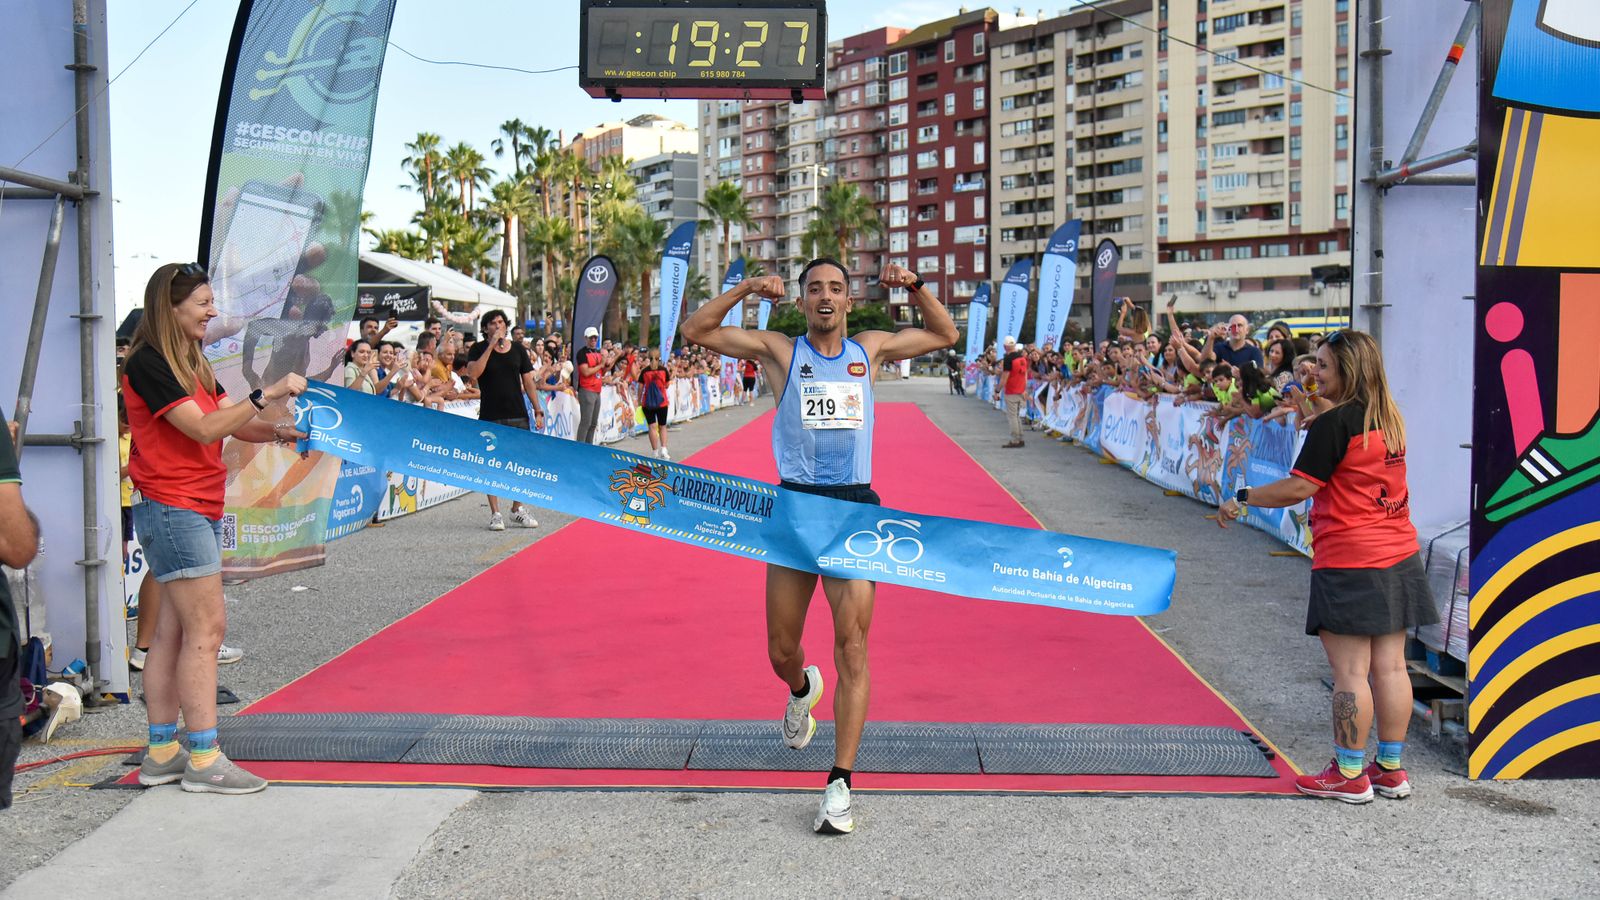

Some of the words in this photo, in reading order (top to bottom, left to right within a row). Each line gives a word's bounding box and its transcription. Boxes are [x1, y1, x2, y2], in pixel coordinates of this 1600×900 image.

[1047, 264, 1062, 332] Sergeyco
[806, 399, 836, 416] 219
[309, 430, 363, 454] BIKES
[411, 438, 450, 457] Puerto
[453, 447, 485, 466] Bahía
[488, 455, 502, 469] de
[505, 460, 559, 482] Algeciras
[407, 461, 442, 475] Autoridad
[442, 468, 472, 484] Portuaria
[473, 477, 482, 485] de
[484, 478, 491, 487] la
[511, 485, 520, 494] de
[520, 487, 553, 501] Algeciras
[672, 475, 722, 506] CARRERA
[724, 487, 774, 518] POPULAR
[678, 499, 702, 510] PUERTO
[703, 504, 720, 514] BAHÍA
[729, 511, 763, 523] ALGECIRAS
[694, 524, 725, 537] Algeciras
[702, 521, 719, 530] Puerto
[241, 535, 260, 544] 615
[817, 555, 892, 574] SPECIAL
[896, 566, 946, 583] BIKES
[992, 562, 1029, 579] Puerto
[1032, 566, 1063, 582] Bahía
[1066, 571, 1080, 585] de
[1083, 574, 1133, 592] Algeciras
[992, 585, 1025, 598] Autoridad
[1026, 589, 1056, 600] Portuaria
[1057, 593, 1065, 601] de
[1067, 594, 1073, 602] la
[1094, 598, 1102, 606] de
[1103, 599, 1135, 609] Algeciras
